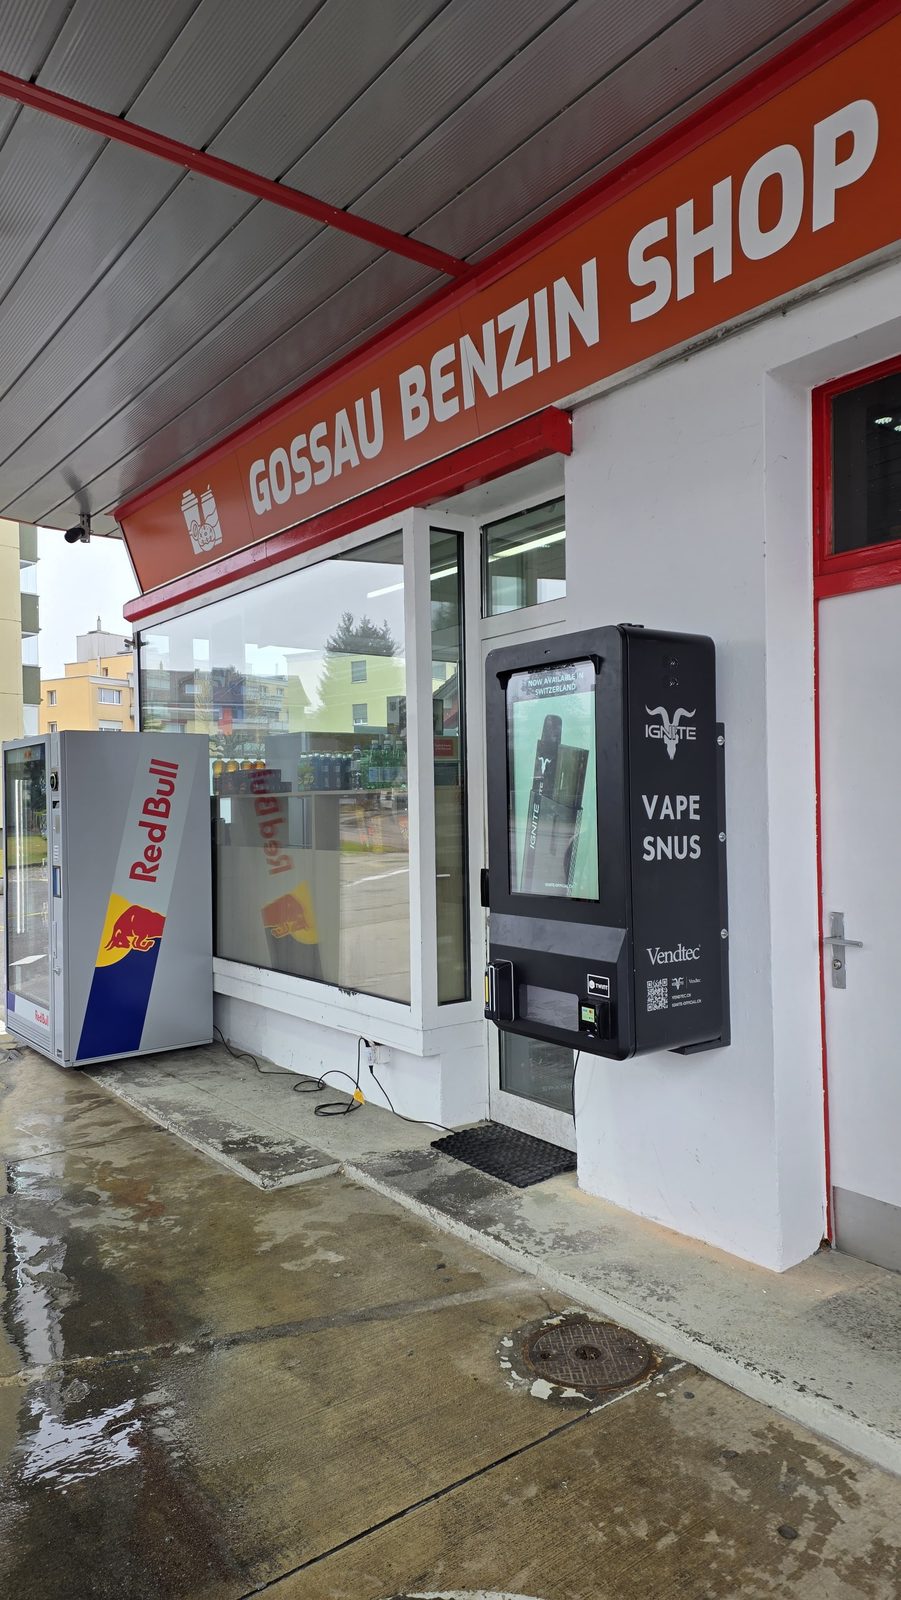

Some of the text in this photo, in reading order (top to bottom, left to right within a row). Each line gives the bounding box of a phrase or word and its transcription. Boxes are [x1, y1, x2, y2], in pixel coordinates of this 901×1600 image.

[249, 99, 879, 516] GOSSAU BENZIN SHOP
[528, 672, 584, 687] NOW AVAILABLE IN
[535, 683, 576, 696] SWITZERLAND
[645, 724, 697, 740] IGNITE
[128, 758, 179, 882] Red Bull
[641, 794, 700, 820] VAPE
[529, 803, 540, 849] IGNITE
[642, 834, 701, 861] SNUS
[646, 943, 700, 965] Vendtec
